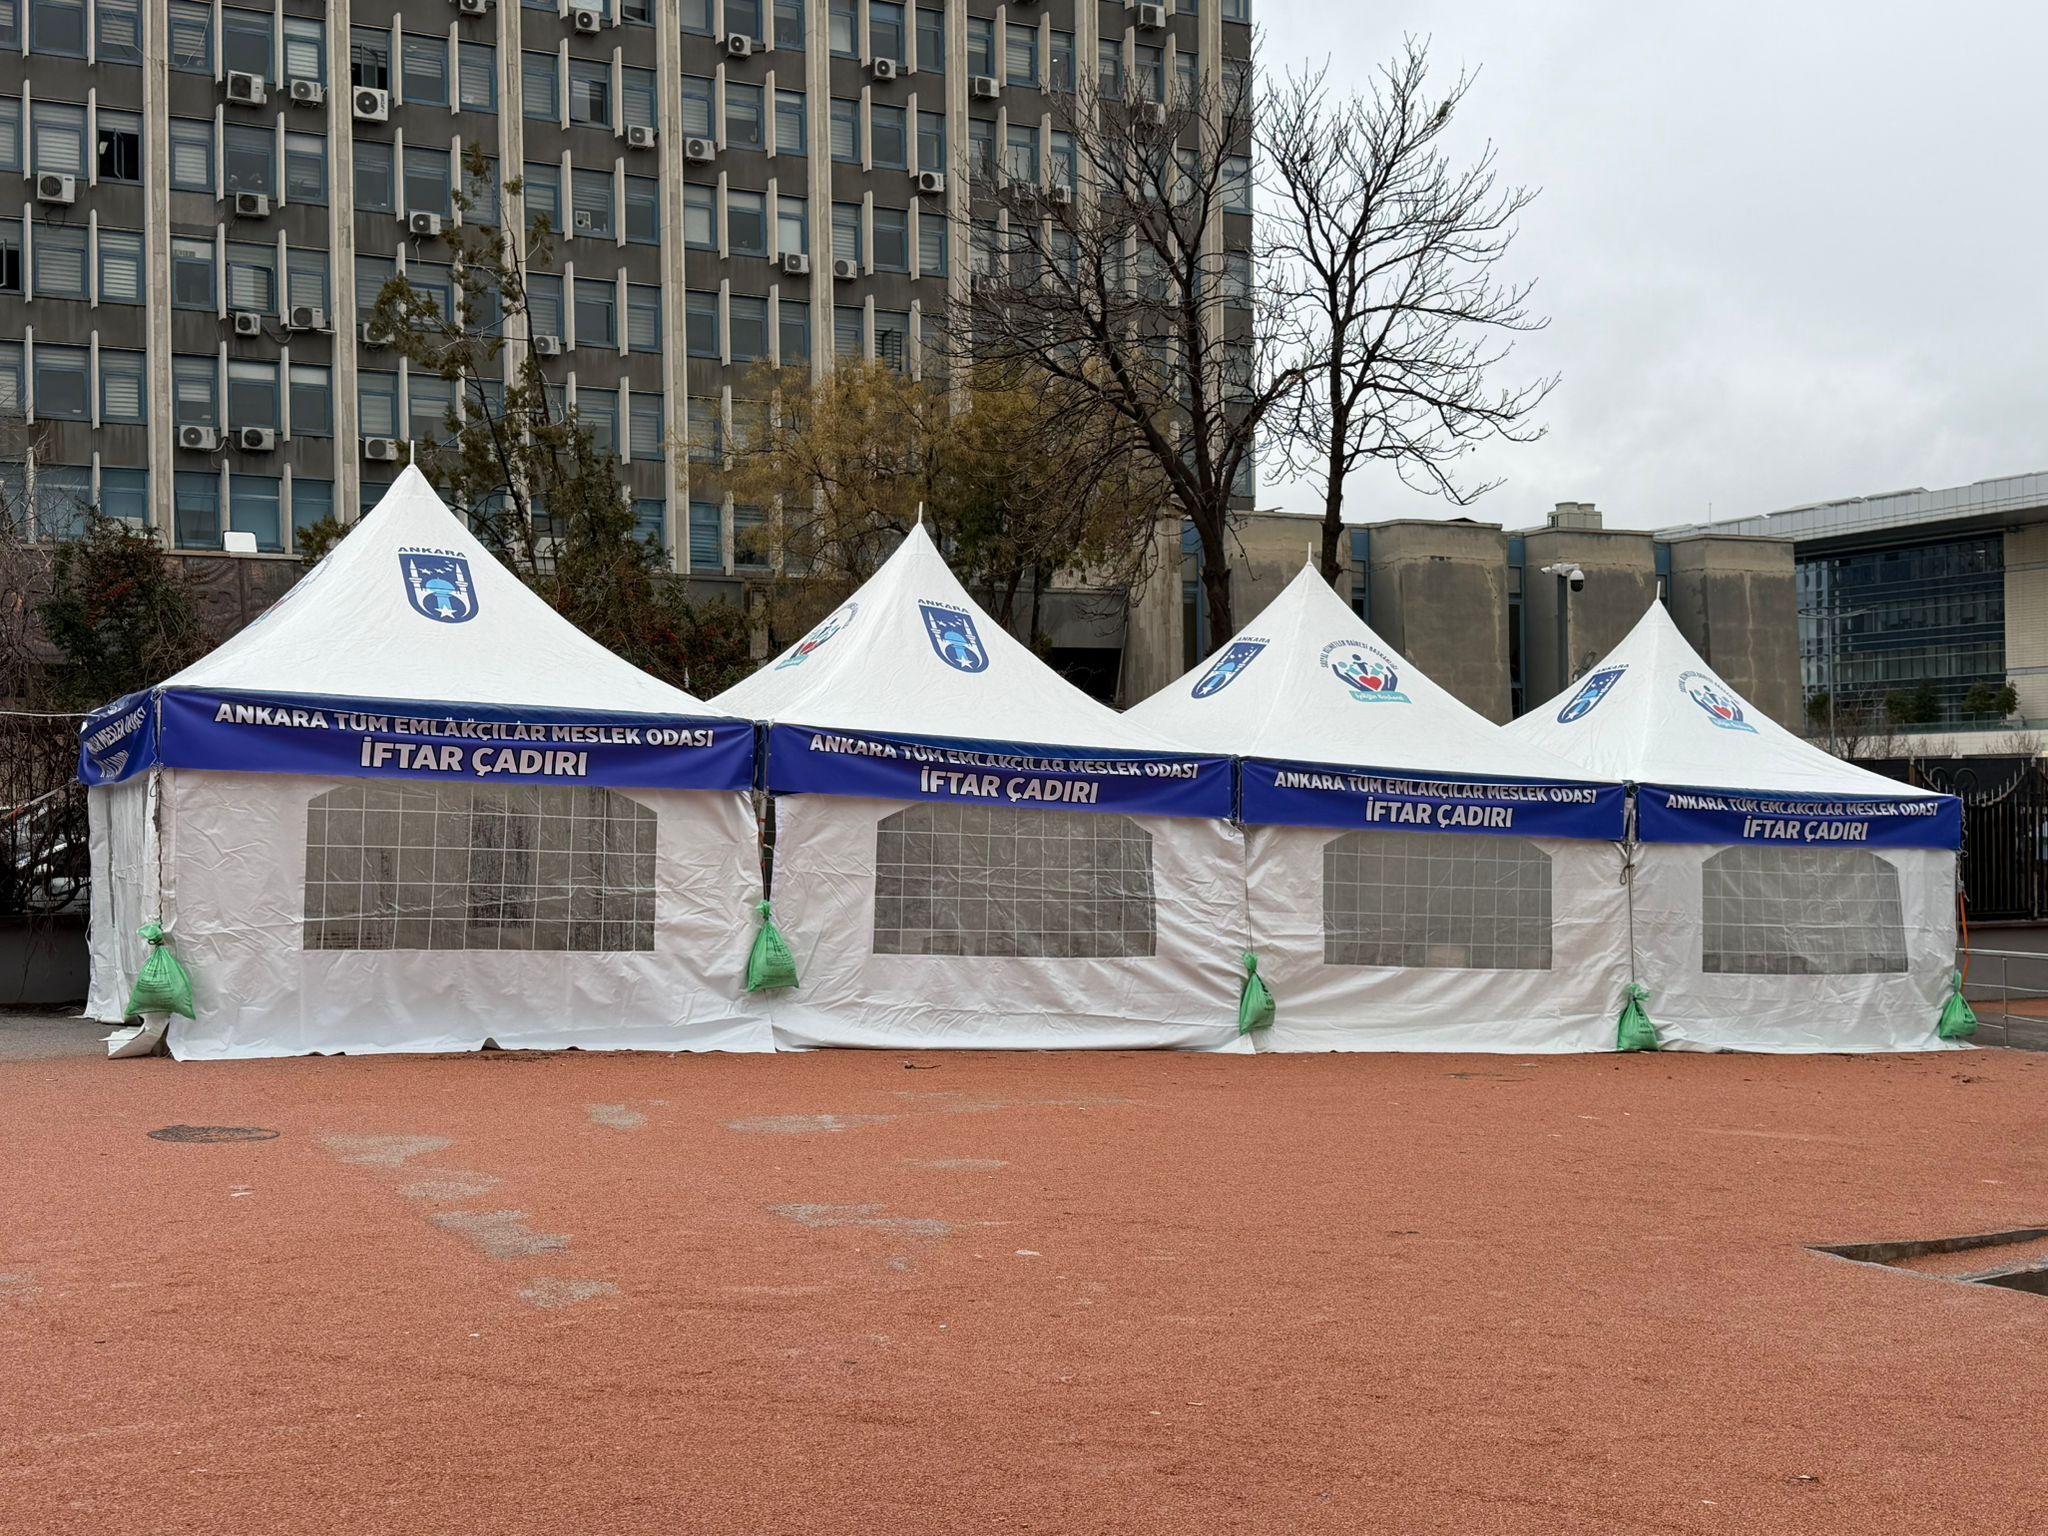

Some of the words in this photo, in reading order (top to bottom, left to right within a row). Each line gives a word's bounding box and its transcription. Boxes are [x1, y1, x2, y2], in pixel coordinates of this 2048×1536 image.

[397, 546, 467, 558] ANKARA
[917, 598, 969, 613] ANKARA
[214, 703, 329, 729] ANKARA
[394, 717, 547, 741] EMLAKÇILAR
[551, 725, 641, 745] MESLEK
[646, 728, 714, 747] ODASI
[360, 735, 463, 771] İFTAR
[471, 747, 588, 777] ÇADIRI
[809, 734, 897, 759] ANKARA
[900, 744, 944, 762] TÜM
[946, 750, 1067, 772] EMLAKÇILAR
[1069, 760, 1142, 776] MESLEK
[1144, 763, 1199, 779] ODASI
[920, 765, 1000, 798] İFTAR
[1006, 776, 1099, 804] ÇADIRI
[1274, 771, 1345, 791] ANKARA
[1348, 775, 1382, 794] TÜM
[1386, 779, 1484, 799] EMLAKÇILAR
[1487, 785, 1548, 801] MESLEK
[1550, 788, 1597, 804] ODASI
[1366, 796, 1432, 825] İFTAR
[1436, 804, 1513, 829] ÇADIRI
[1665, 794, 1728, 811] ANKARA
[1728, 798, 1759, 812] TÜM
[1760, 801, 1846, 816] EMLAKÇILAR
[1846, 802, 1899, 816] MESLEK
[1900, 802, 1939, 817] ODASI
[1743, 815, 1800, 839] İFTAR
[1804, 821, 1868, 843] ÇADIRI
